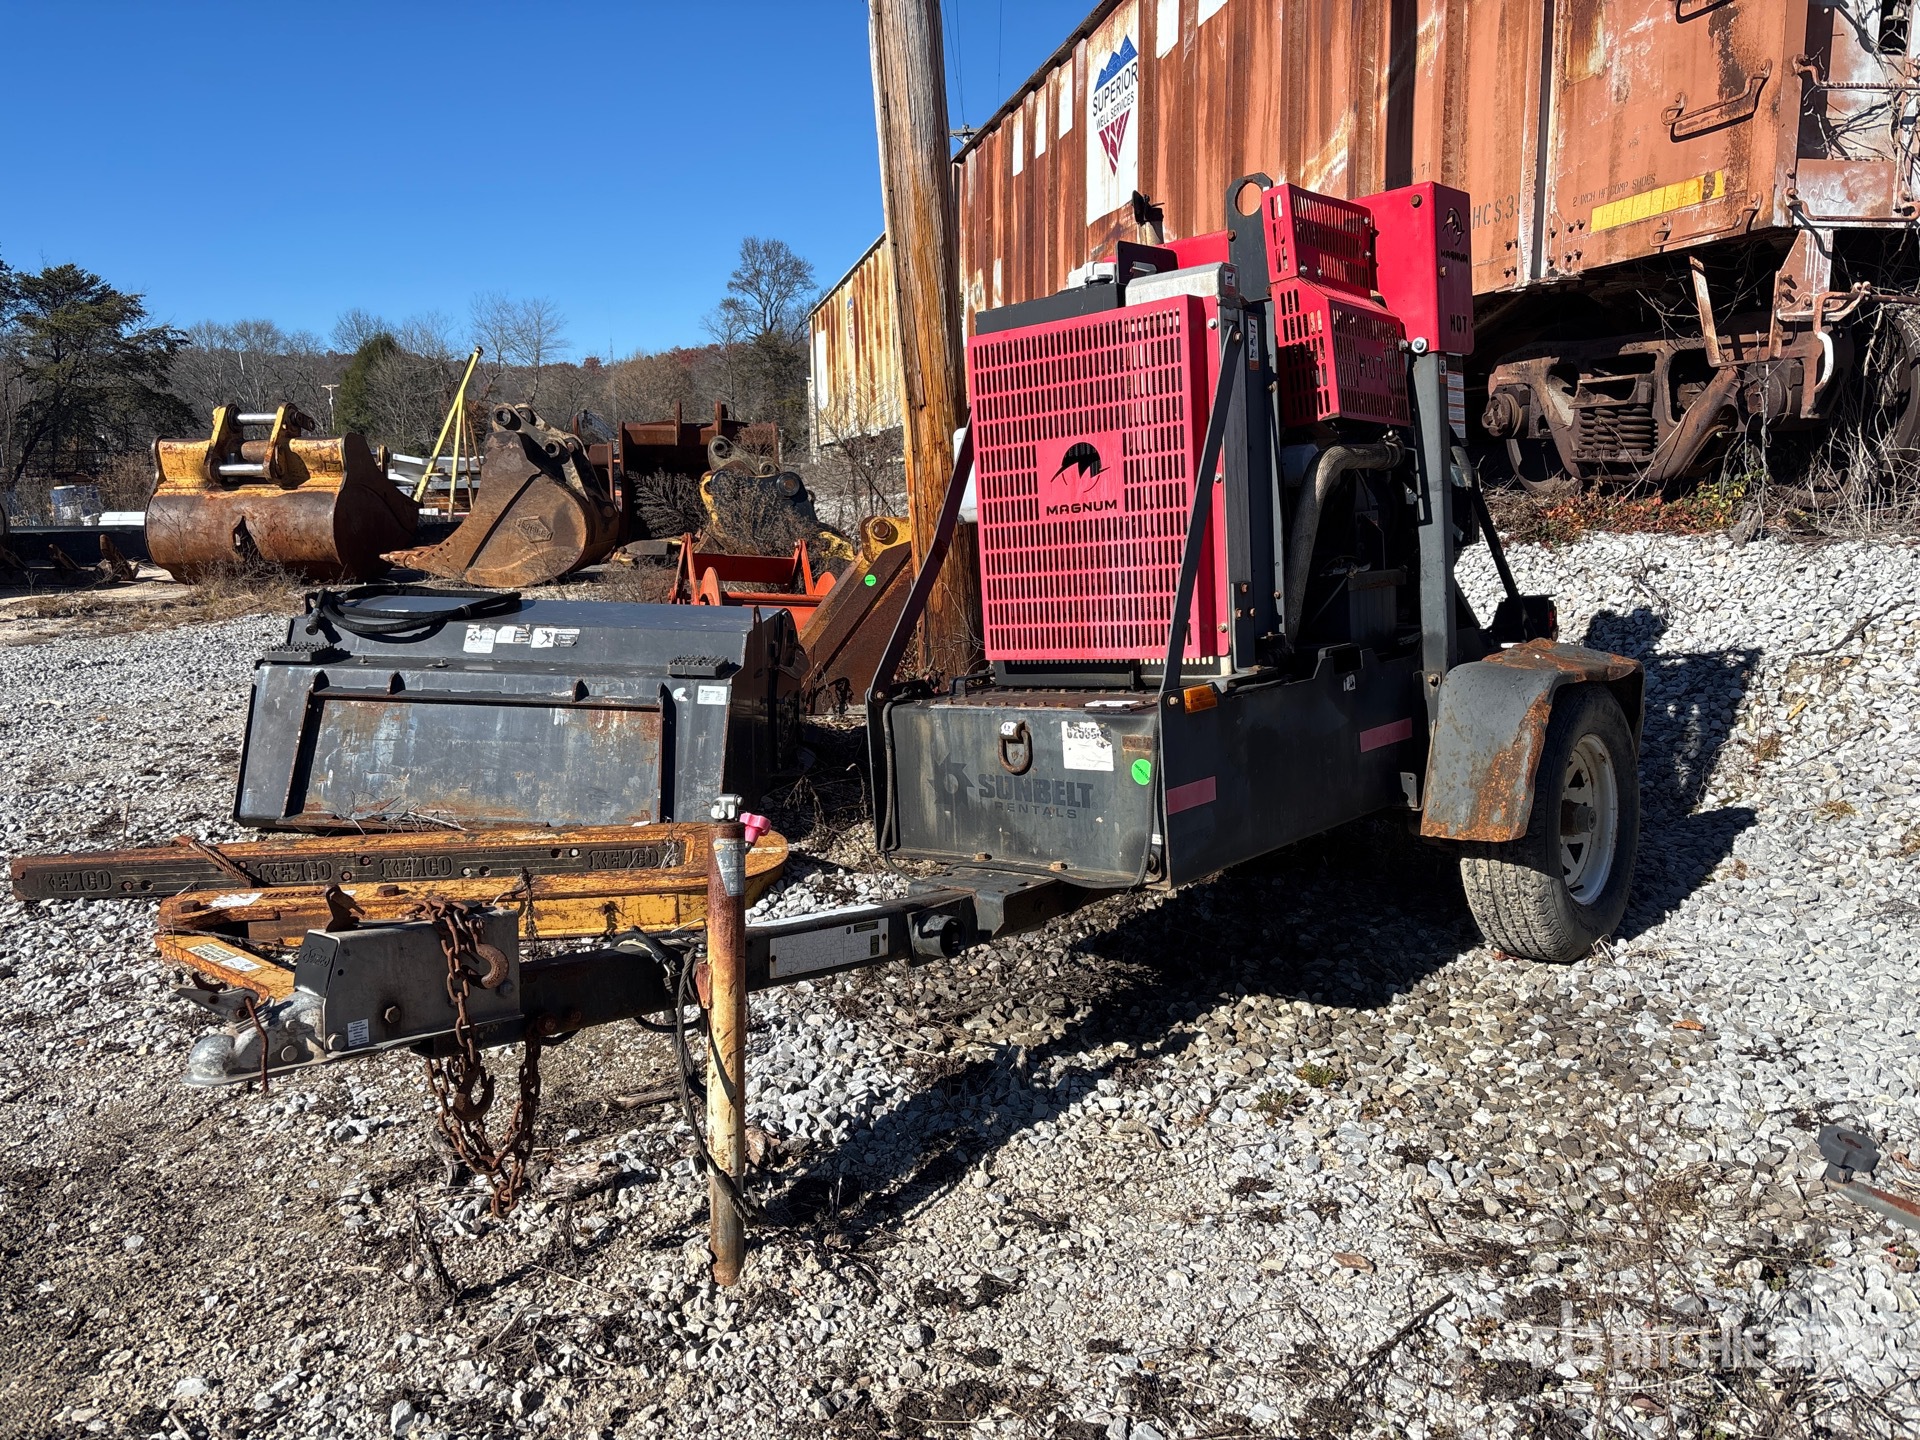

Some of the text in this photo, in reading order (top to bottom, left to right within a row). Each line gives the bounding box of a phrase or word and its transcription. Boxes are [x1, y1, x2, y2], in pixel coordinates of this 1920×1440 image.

[1093, 62, 1139, 117] SUPERIOR
[1096, 90, 1134, 130] WELL SERVICES
[1450, 314, 1468, 333] HOT
[1359, 352, 1383, 381] HOT
[1046, 500, 1117, 516] MAGNUM
[978, 773, 1094, 809] SUNBELT
[995, 801, 1077, 819] RENTALS
[259, 860, 333, 884] KENCO
[382, 856, 453, 880] KENCO
